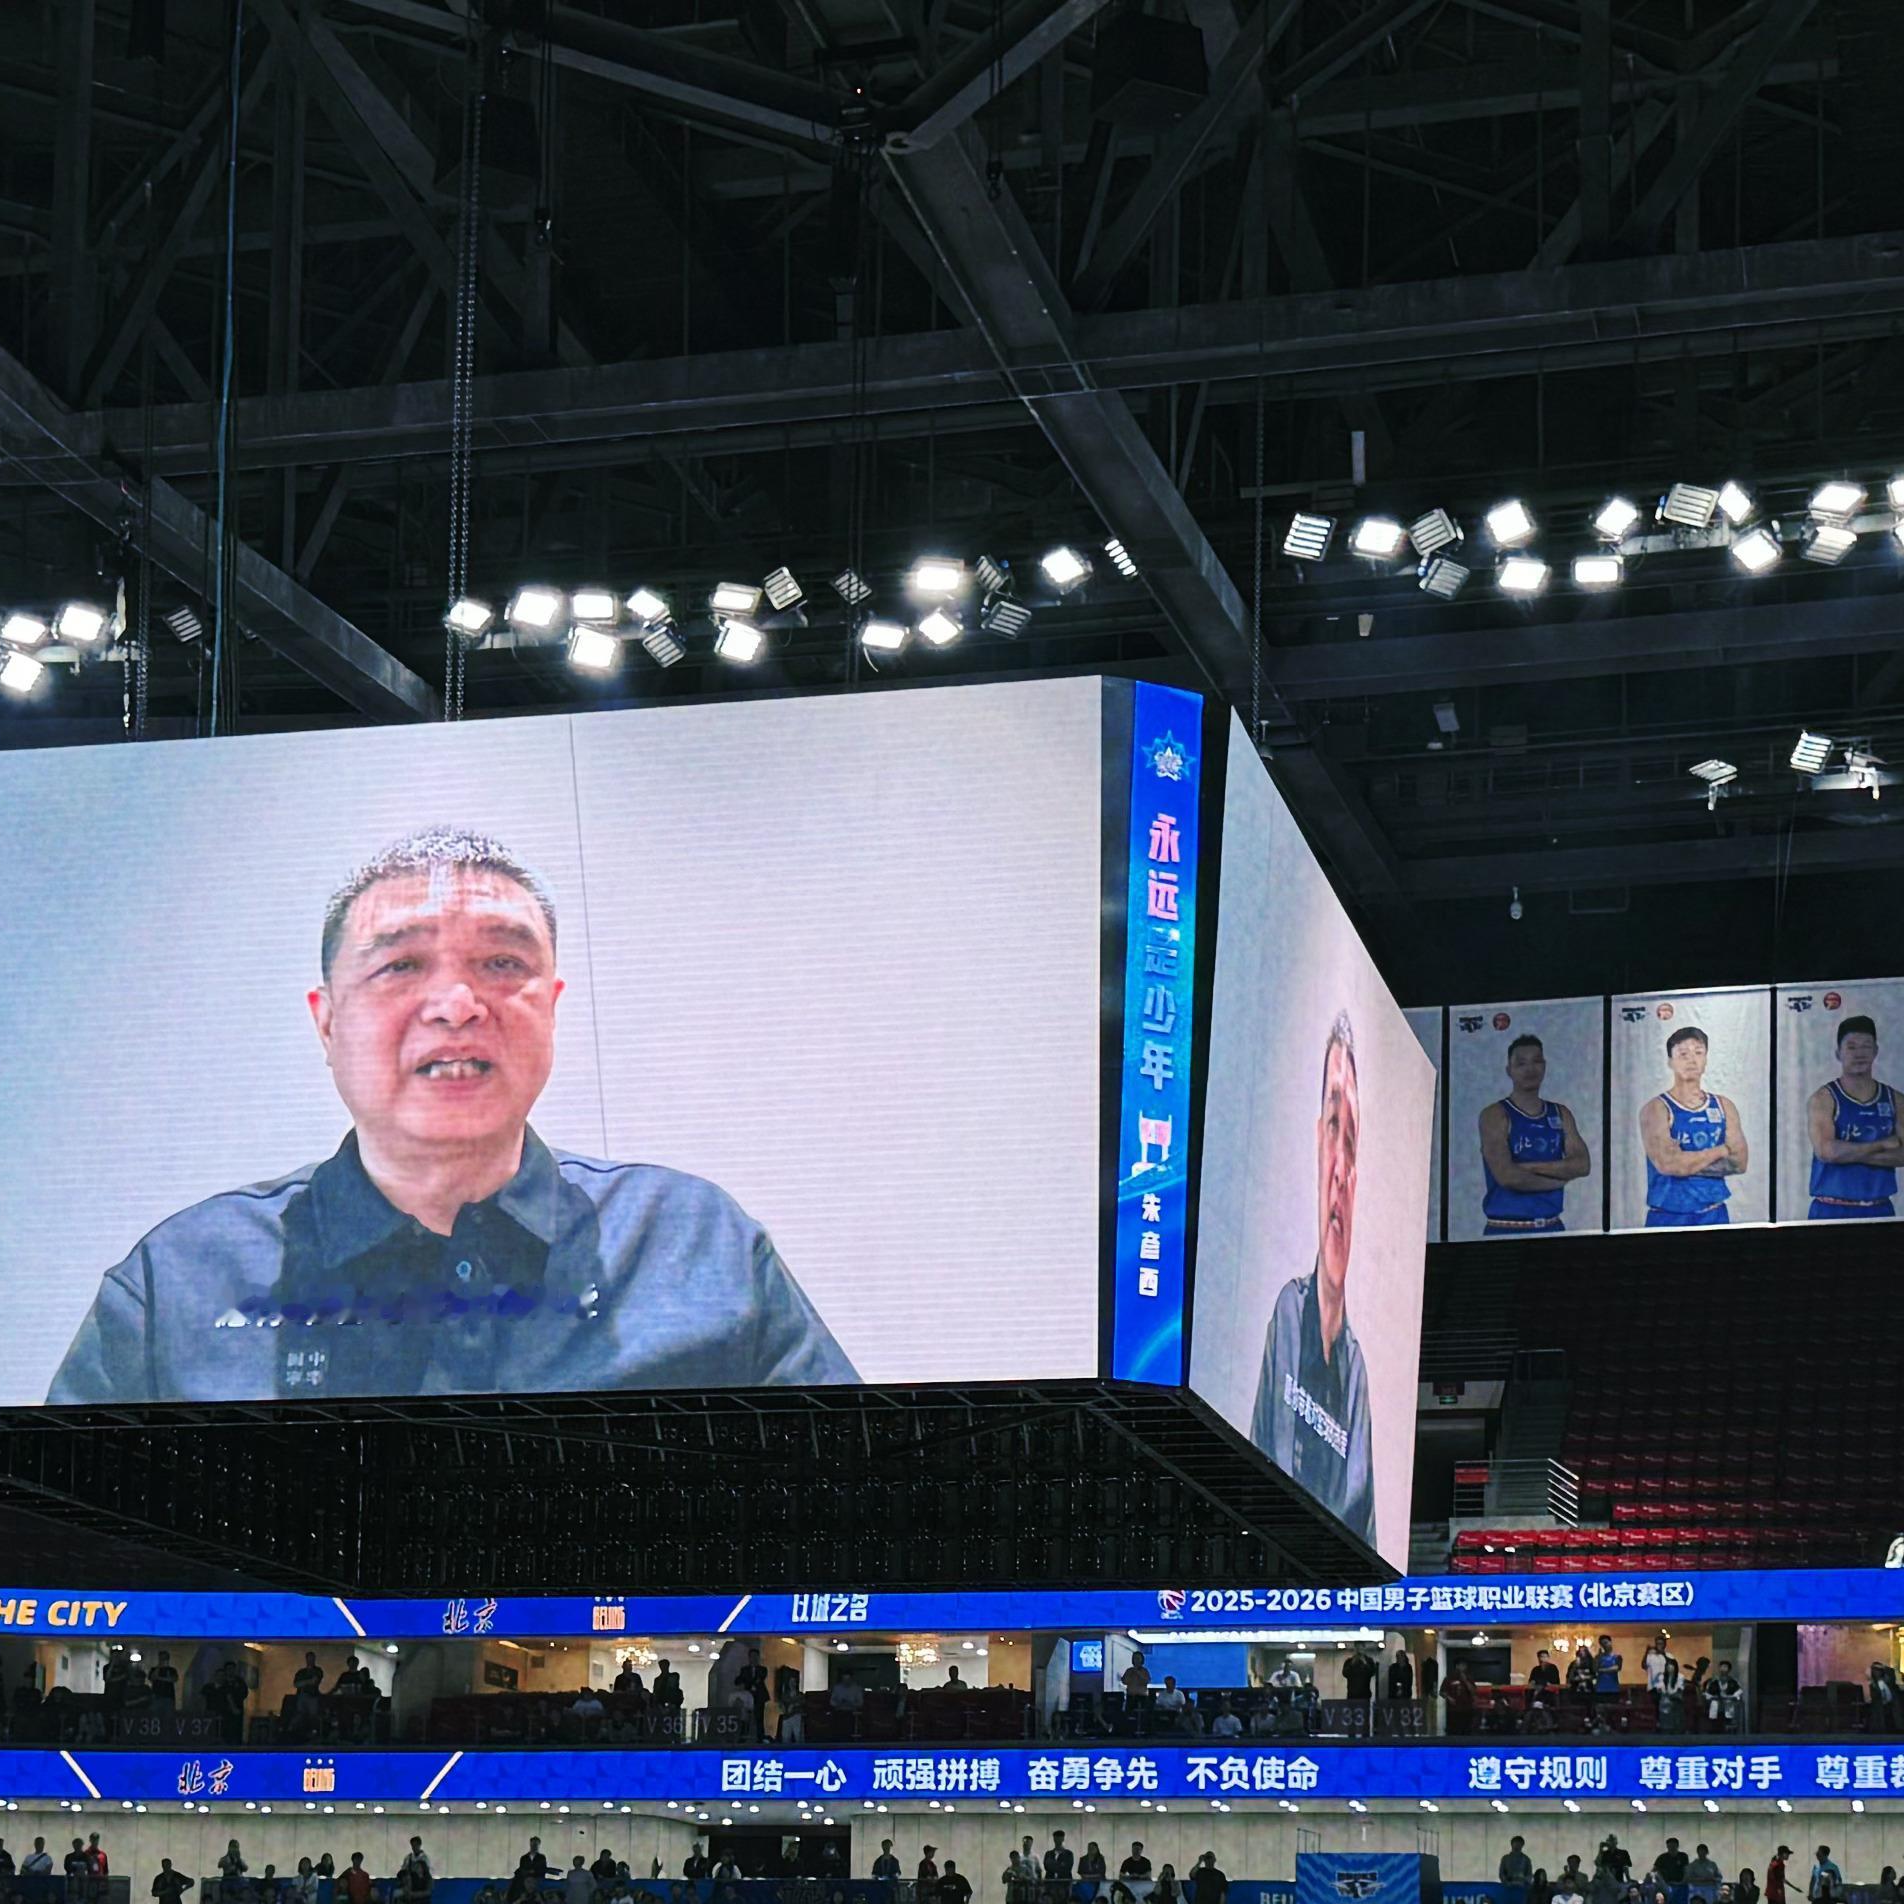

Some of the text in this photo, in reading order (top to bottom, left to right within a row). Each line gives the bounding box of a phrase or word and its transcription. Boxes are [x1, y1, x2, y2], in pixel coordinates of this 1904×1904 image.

[791, 1593, 869, 1622] 以城之名
[1190, 1587, 1332, 1614] 2025-2026
[47, 1600, 128, 1628] CITY
[442, 1598, 498, 1635] 北京
[124, 1716, 161, 1736] V 38
[176, 1716, 213, 1736] V 37
[647, 1714, 684, 1734] V 36
[702, 1713, 739, 1733] V 35
[1324, 1706, 1365, 1726] V 33
[1382, 1706, 1424, 1726] V 32
[177, 1760, 234, 1796] 北京
[721, 1757, 846, 1794] 团结一心
[872, 1756, 1001, 1793] 顽强拼搏
[1027, 1755, 1158, 1793] 奋勇争先
[1186, 1754, 1320, 1792] 不负使命
[1468, 1754, 1608, 1792] 遵守规则
[1638, 1754, 1783, 1792] 尊重对手
